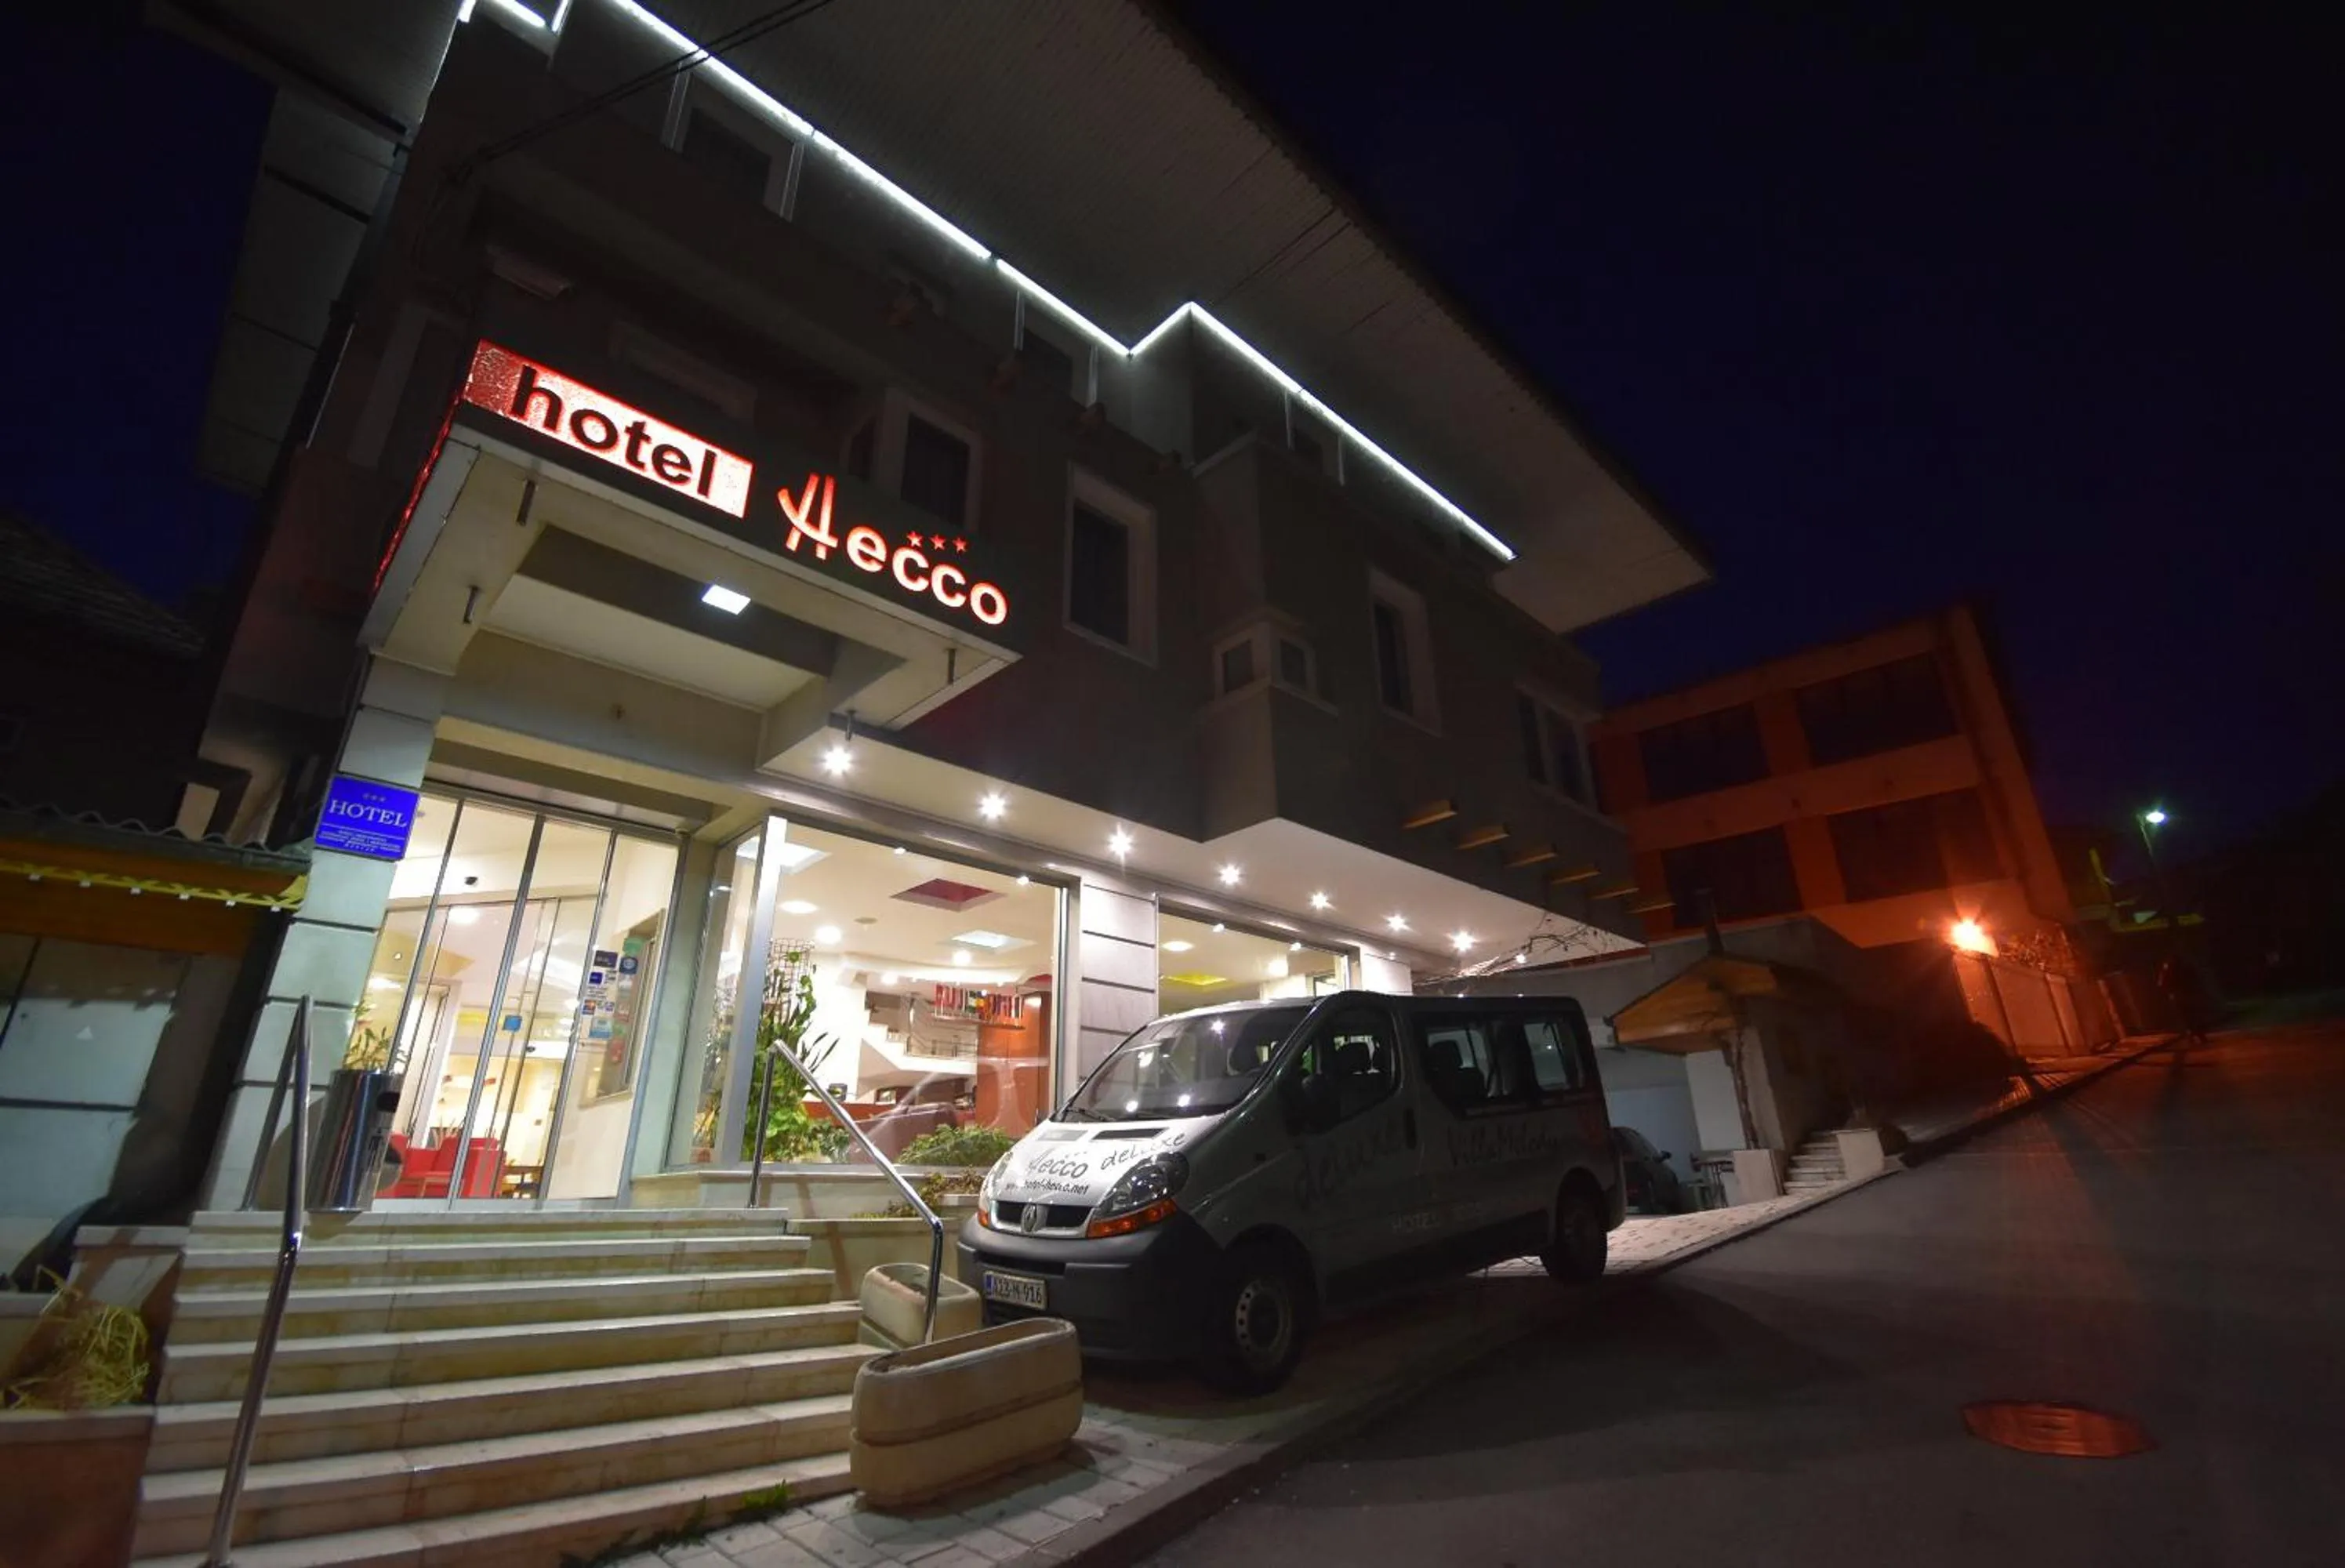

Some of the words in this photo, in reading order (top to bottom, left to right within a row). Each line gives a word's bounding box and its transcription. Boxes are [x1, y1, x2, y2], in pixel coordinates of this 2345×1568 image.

[510, 365, 717, 499] hotel
[777, 472, 1007, 626] Hecco
[329, 799, 408, 828] HOTEL
